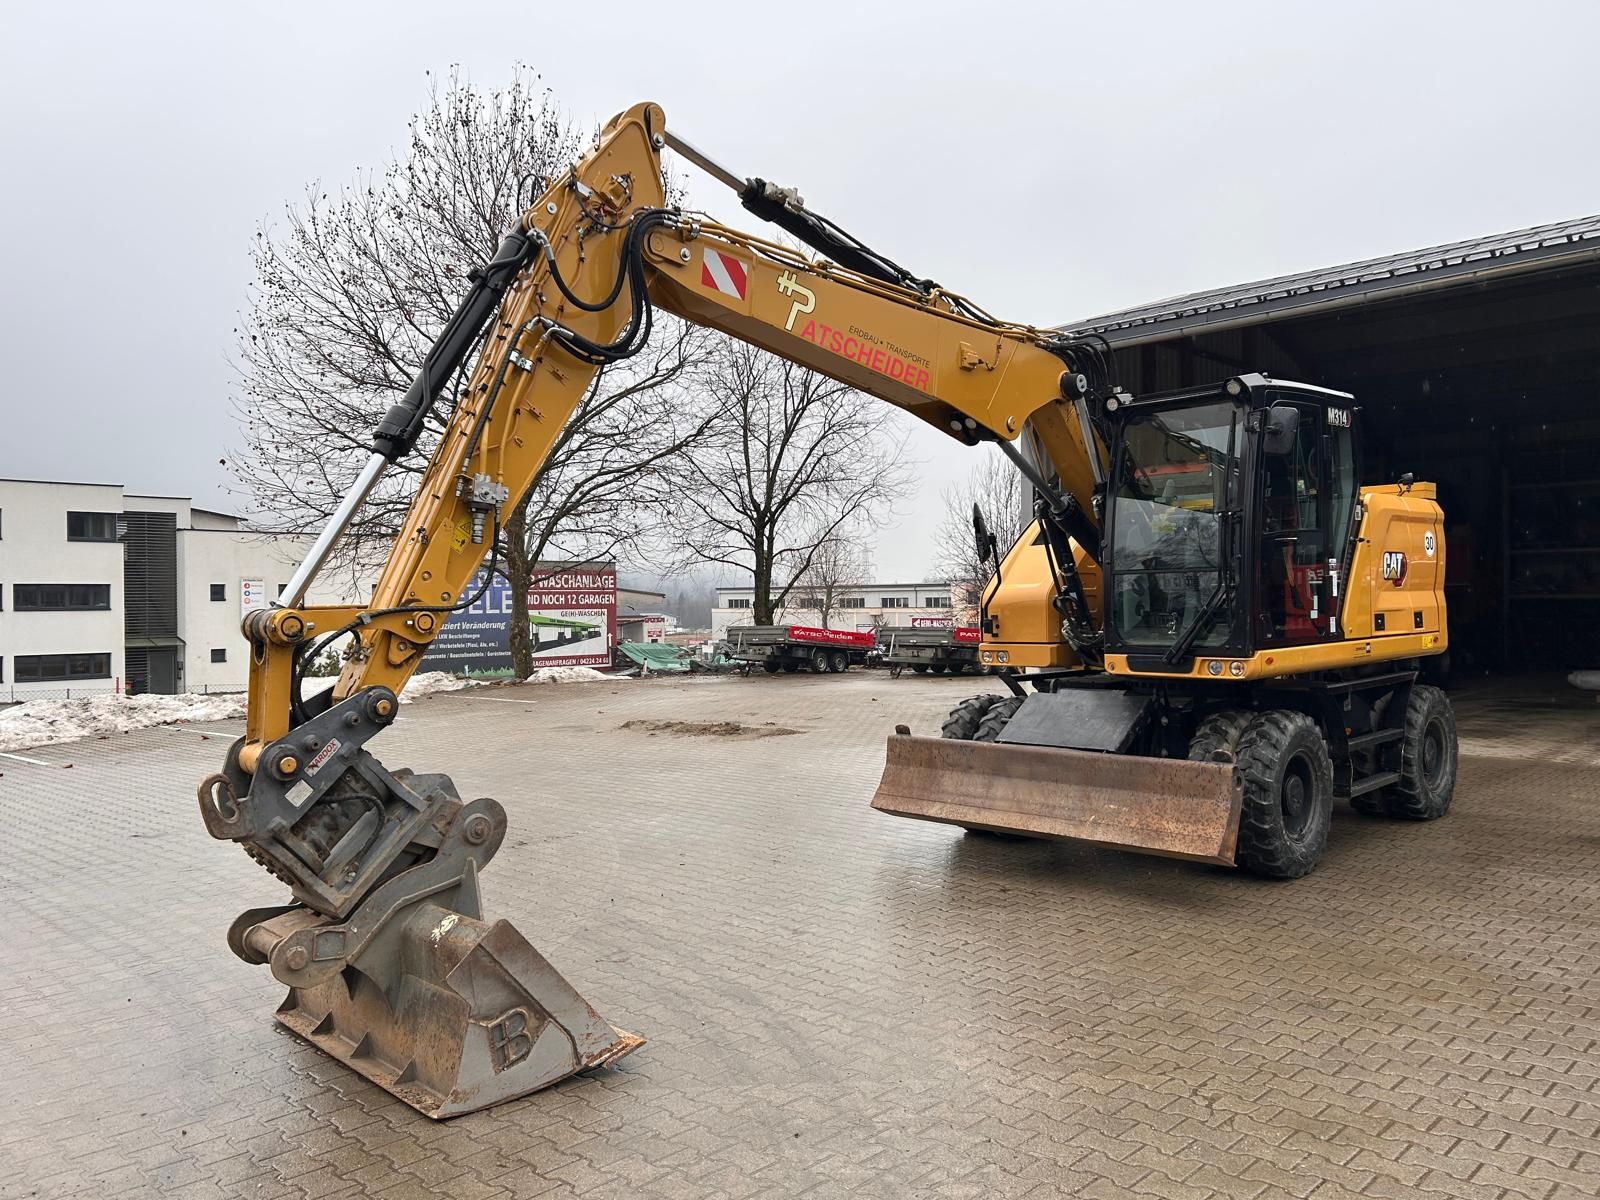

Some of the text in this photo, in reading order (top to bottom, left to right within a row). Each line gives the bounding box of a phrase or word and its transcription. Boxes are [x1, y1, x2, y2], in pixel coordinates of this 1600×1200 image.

[848, 325, 931, 369] ERDBAU TRANSPORTE
[1327, 407, 1348, 425] M314
[1425, 536, 1434, 551] 30
[1383, 552, 1404, 580] CAT
[539, 574, 615, 589] WASCHANLAGE
[527, 594, 615, 605] ND NOCH 12 GARAGEN
[462, 621, 506, 631] Veränderung
